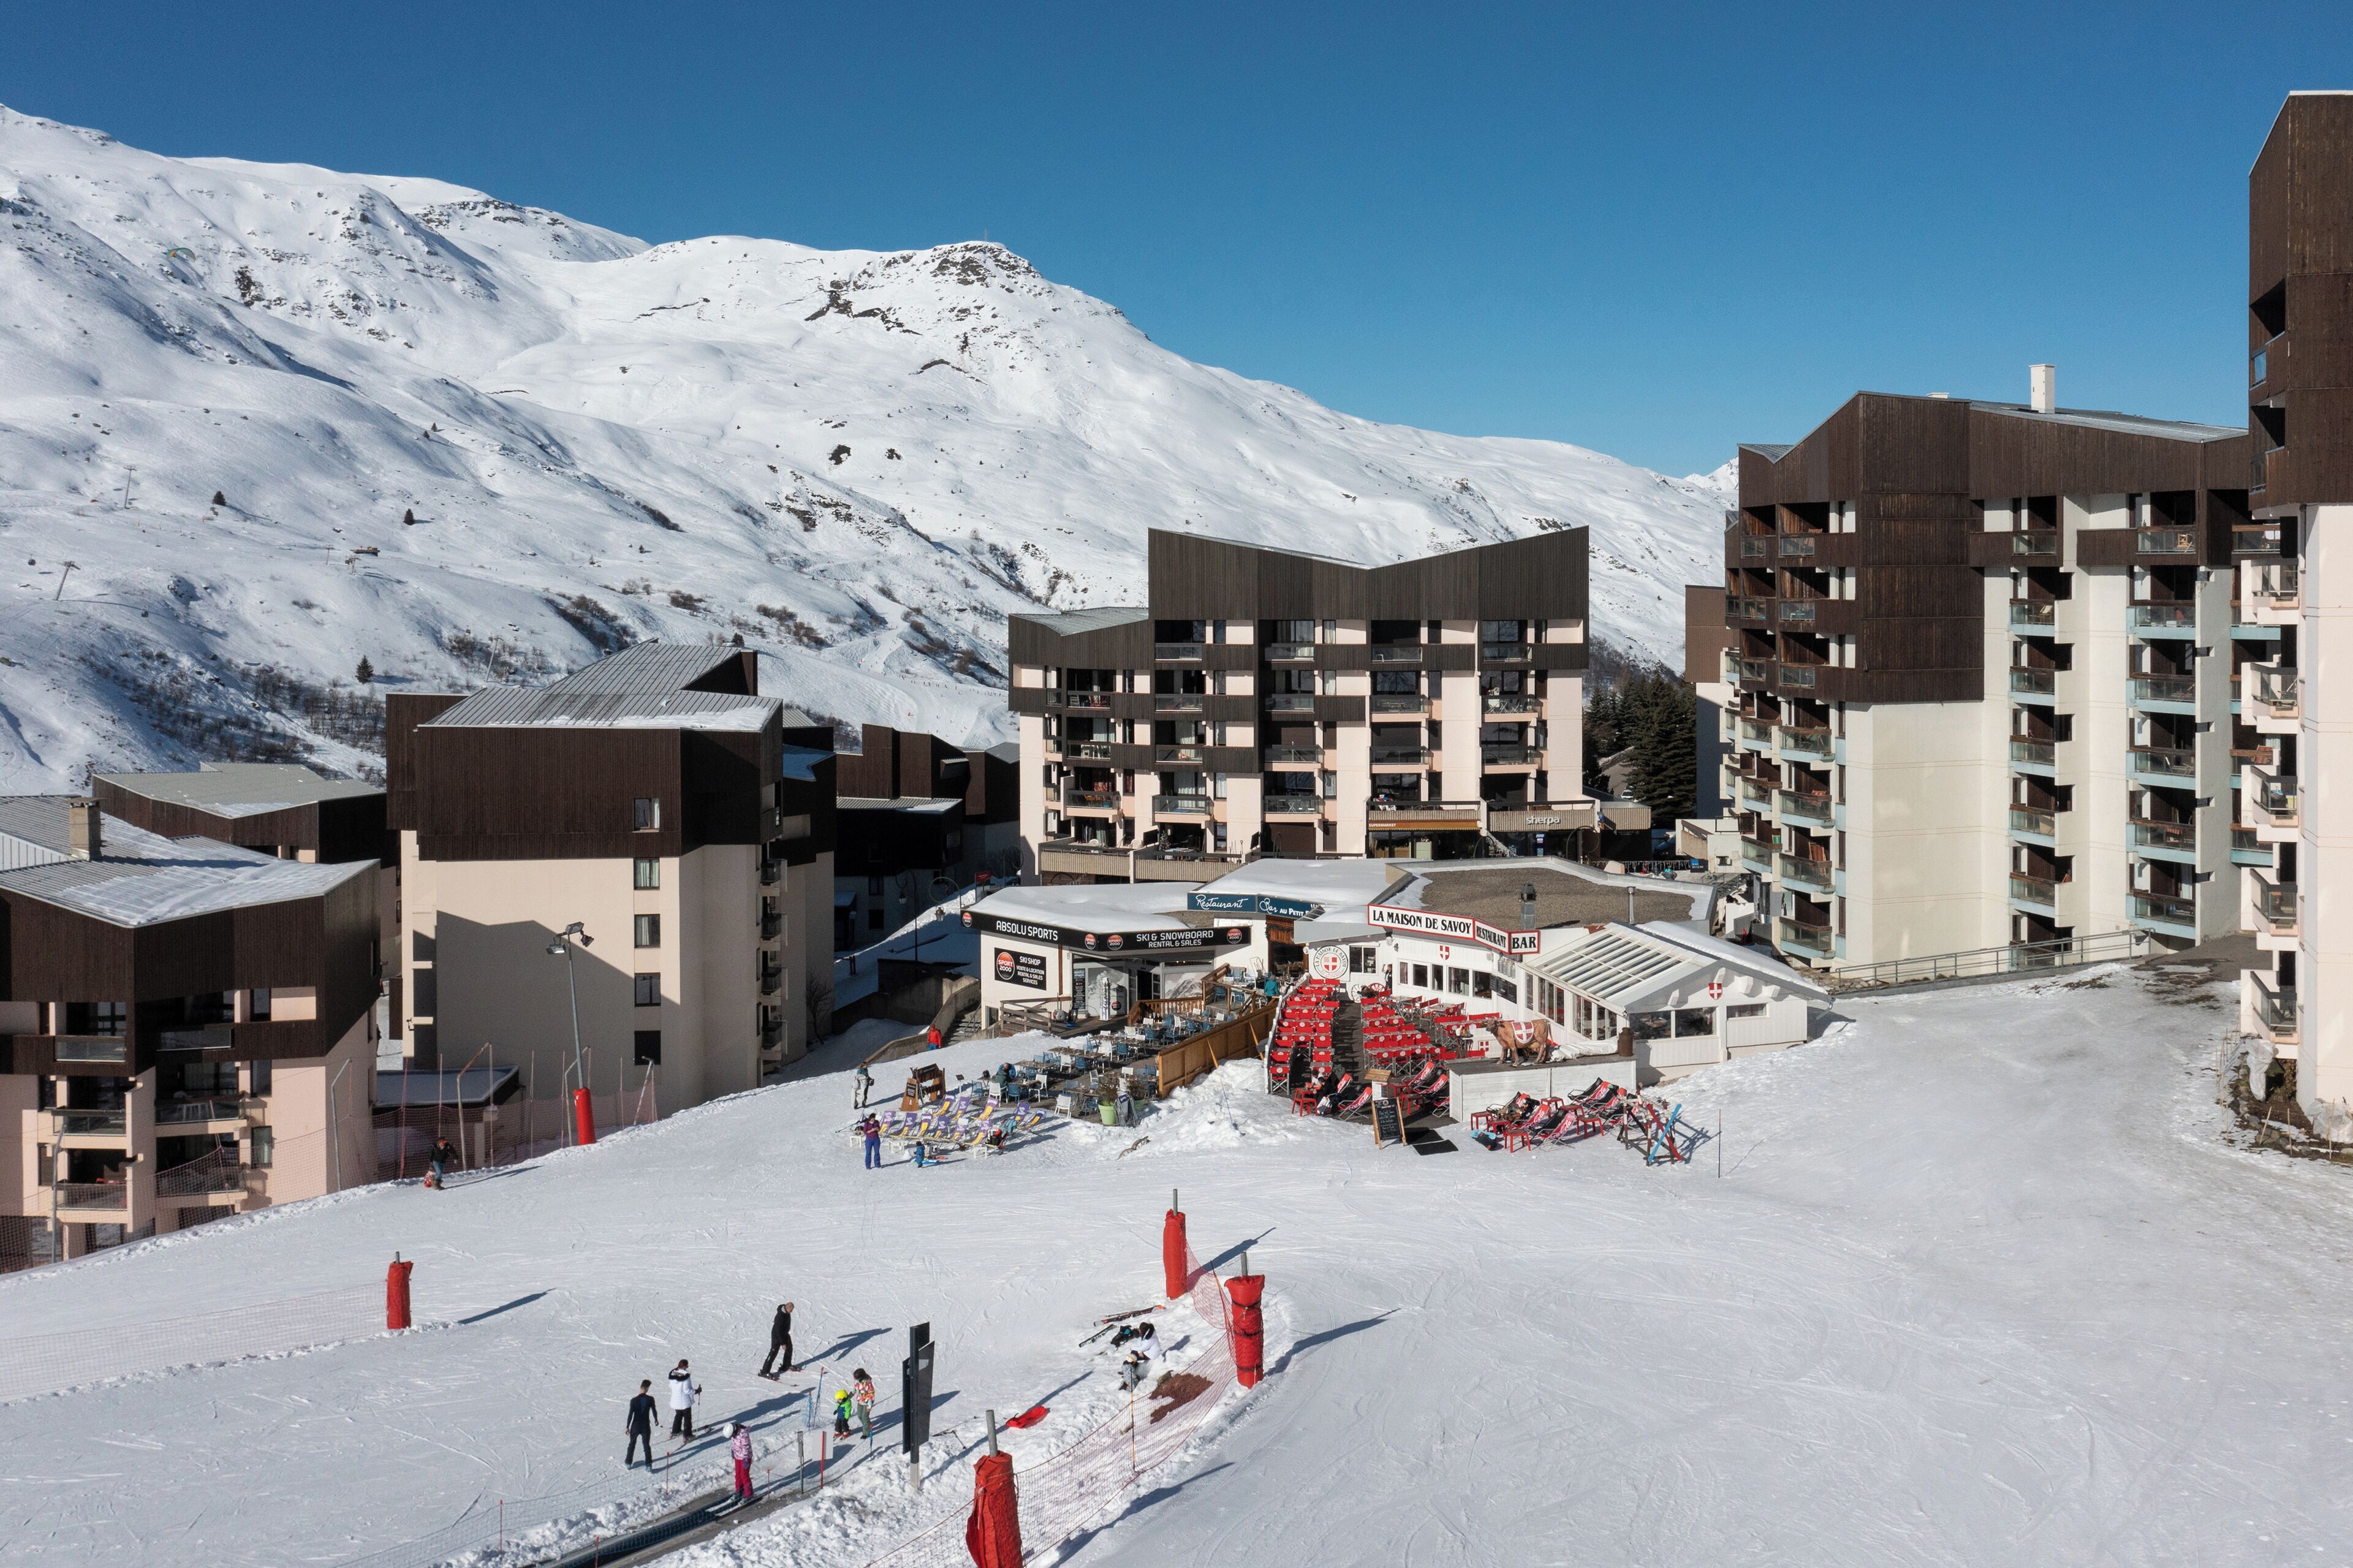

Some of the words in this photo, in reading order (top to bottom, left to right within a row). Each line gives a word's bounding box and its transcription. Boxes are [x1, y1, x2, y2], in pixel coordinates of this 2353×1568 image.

[1526, 816, 1560, 825] sherpa
[1195, 894, 1249, 910] Restaurant
[1259, 897, 1278, 914] Bar
[1373, 909, 1385, 922] LA
[1387, 911, 1422, 927] MAISON
[1425, 917, 1439, 930] DE
[1441, 919, 1472, 934] SAVOY
[996, 920, 1026, 935] ABSOLU
[1027, 925, 1058, 941] SPORTS
[1136, 933, 1150, 942] SKI
[1160, 930, 1214, 940] SNOWBOARD
[1476, 925, 1507, 949] RESTAURANT
[1512, 937, 1537, 950] BAR
